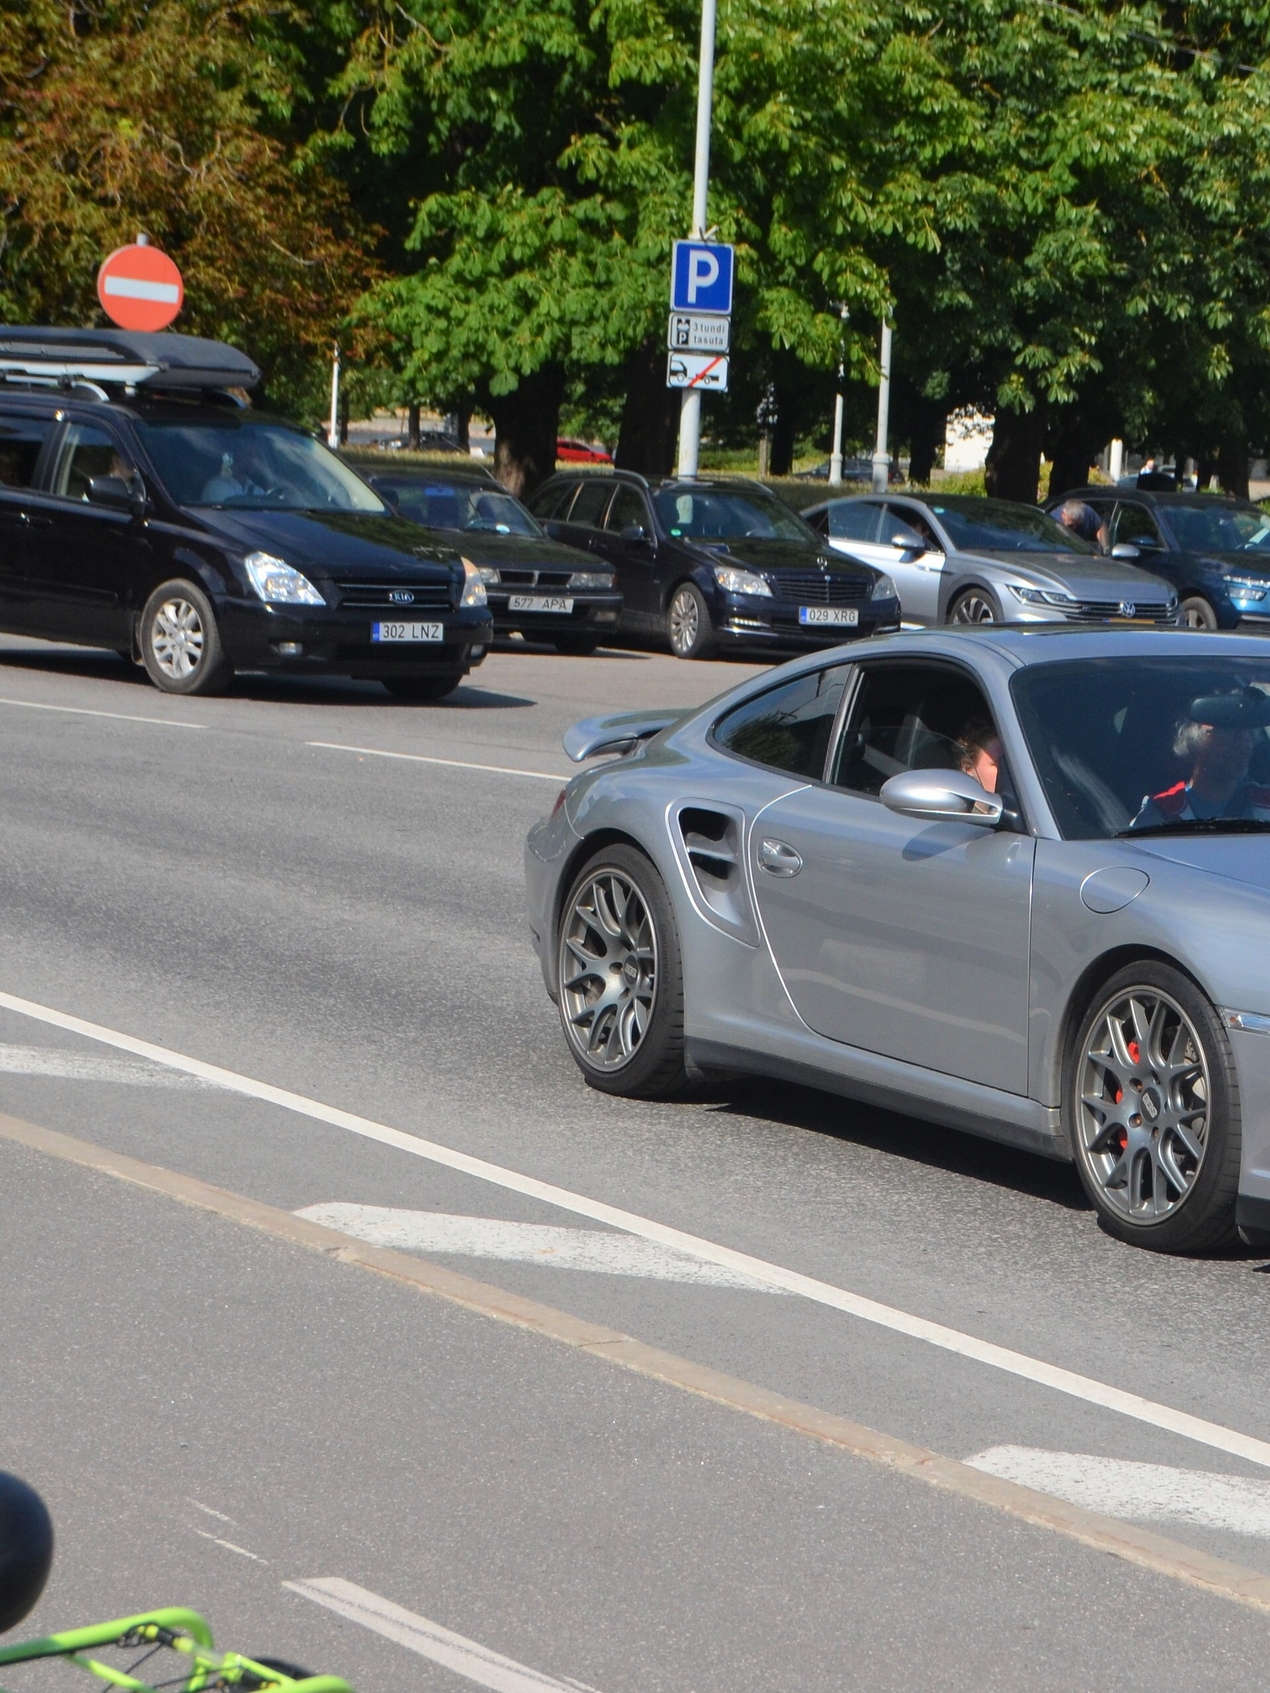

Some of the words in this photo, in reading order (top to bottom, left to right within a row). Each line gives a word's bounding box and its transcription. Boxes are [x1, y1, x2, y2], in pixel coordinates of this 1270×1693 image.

[687, 248, 719, 304] P
[693, 322, 699, 331] 3
[700, 324, 725, 333] tundi
[693, 335, 724, 345] tasuta
[541, 598, 567, 611] APA
[809, 609, 829, 621] 029
[833, 610, 856, 622] XRG
[383, 624, 405, 639] 302
[412, 624, 439, 639] LNZ
